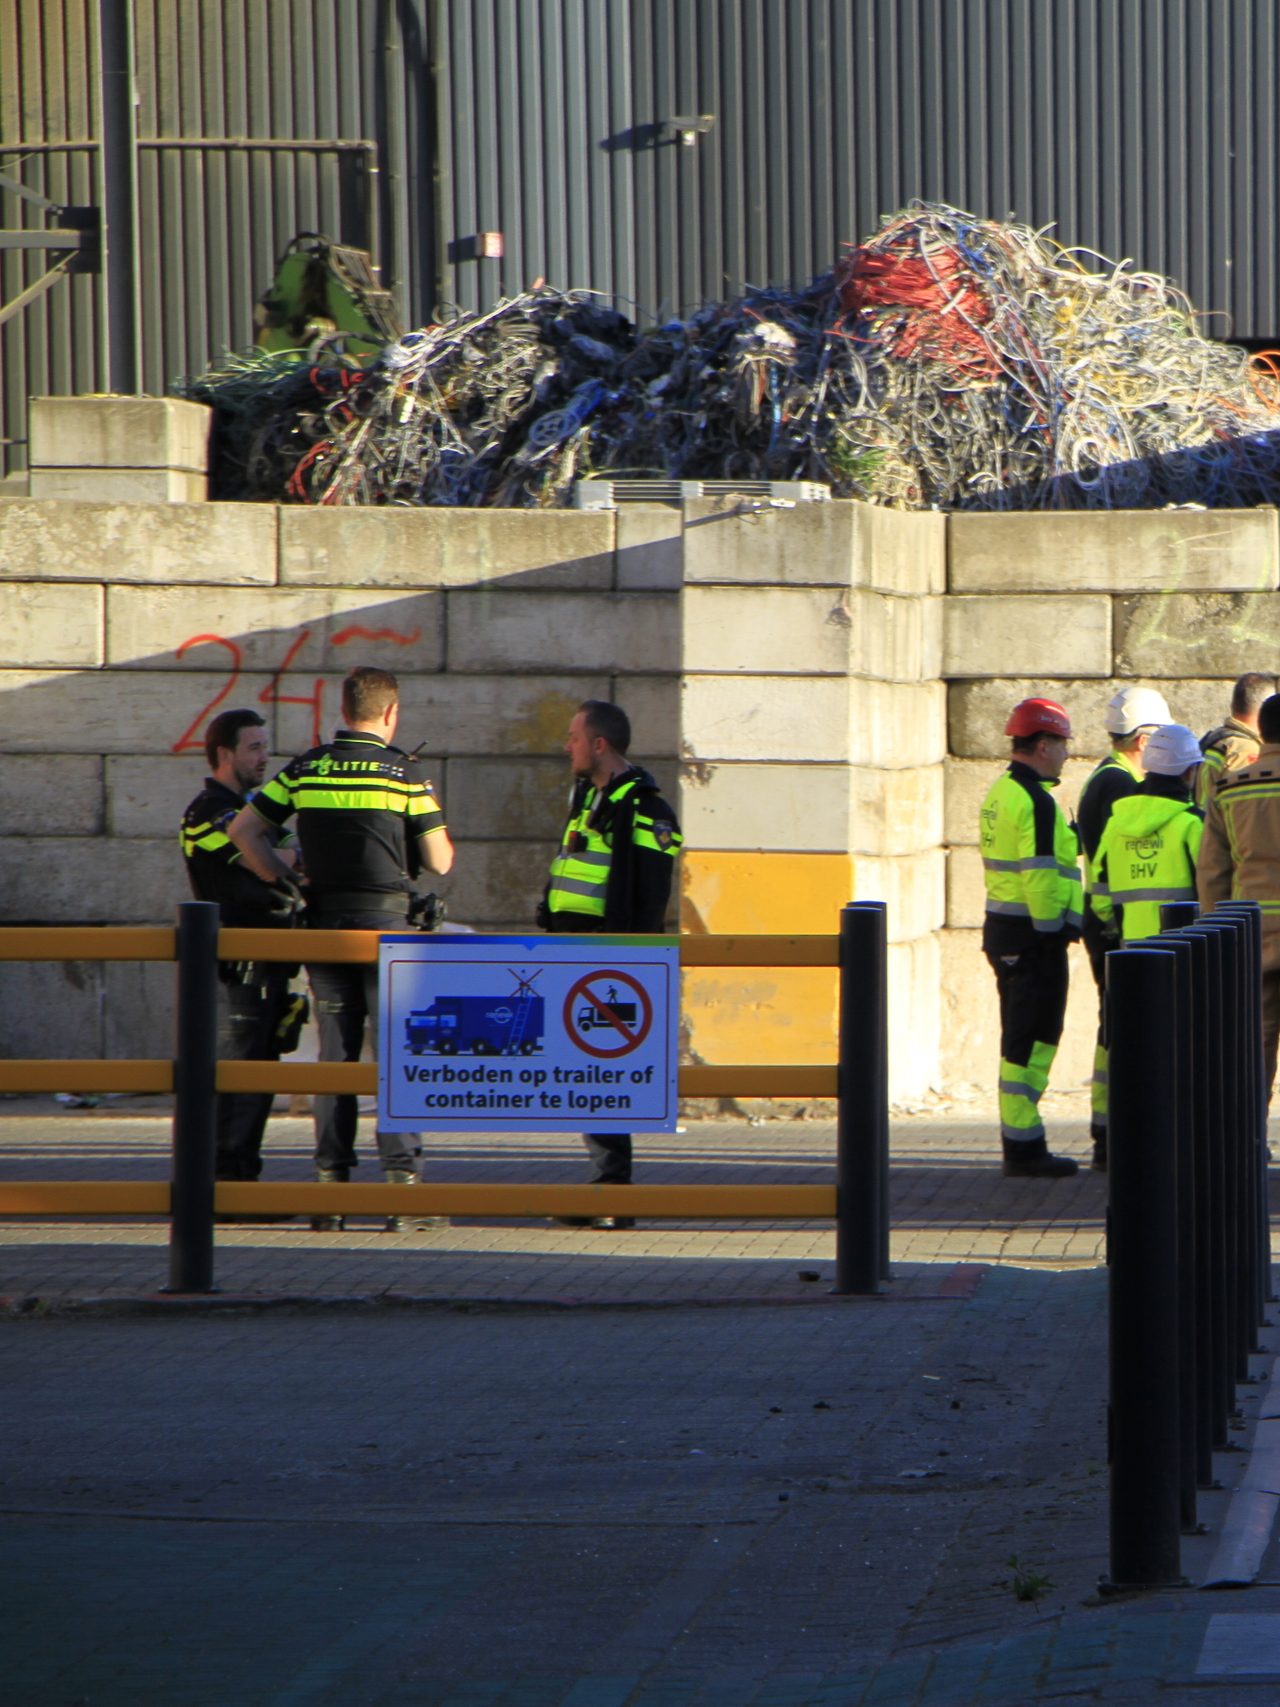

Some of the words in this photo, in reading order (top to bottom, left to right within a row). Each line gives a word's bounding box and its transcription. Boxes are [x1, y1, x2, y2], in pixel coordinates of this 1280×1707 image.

[1130, 863, 1158, 879] BHV
[403, 1065, 513, 1083] Verboden
[519, 1070, 547, 1087] op
[553, 1066, 625, 1083] trailer
[630, 1066, 654, 1084] of
[424, 1089, 534, 1108] container
[539, 1092, 562, 1108] te
[568, 1091, 631, 1112] lopen
